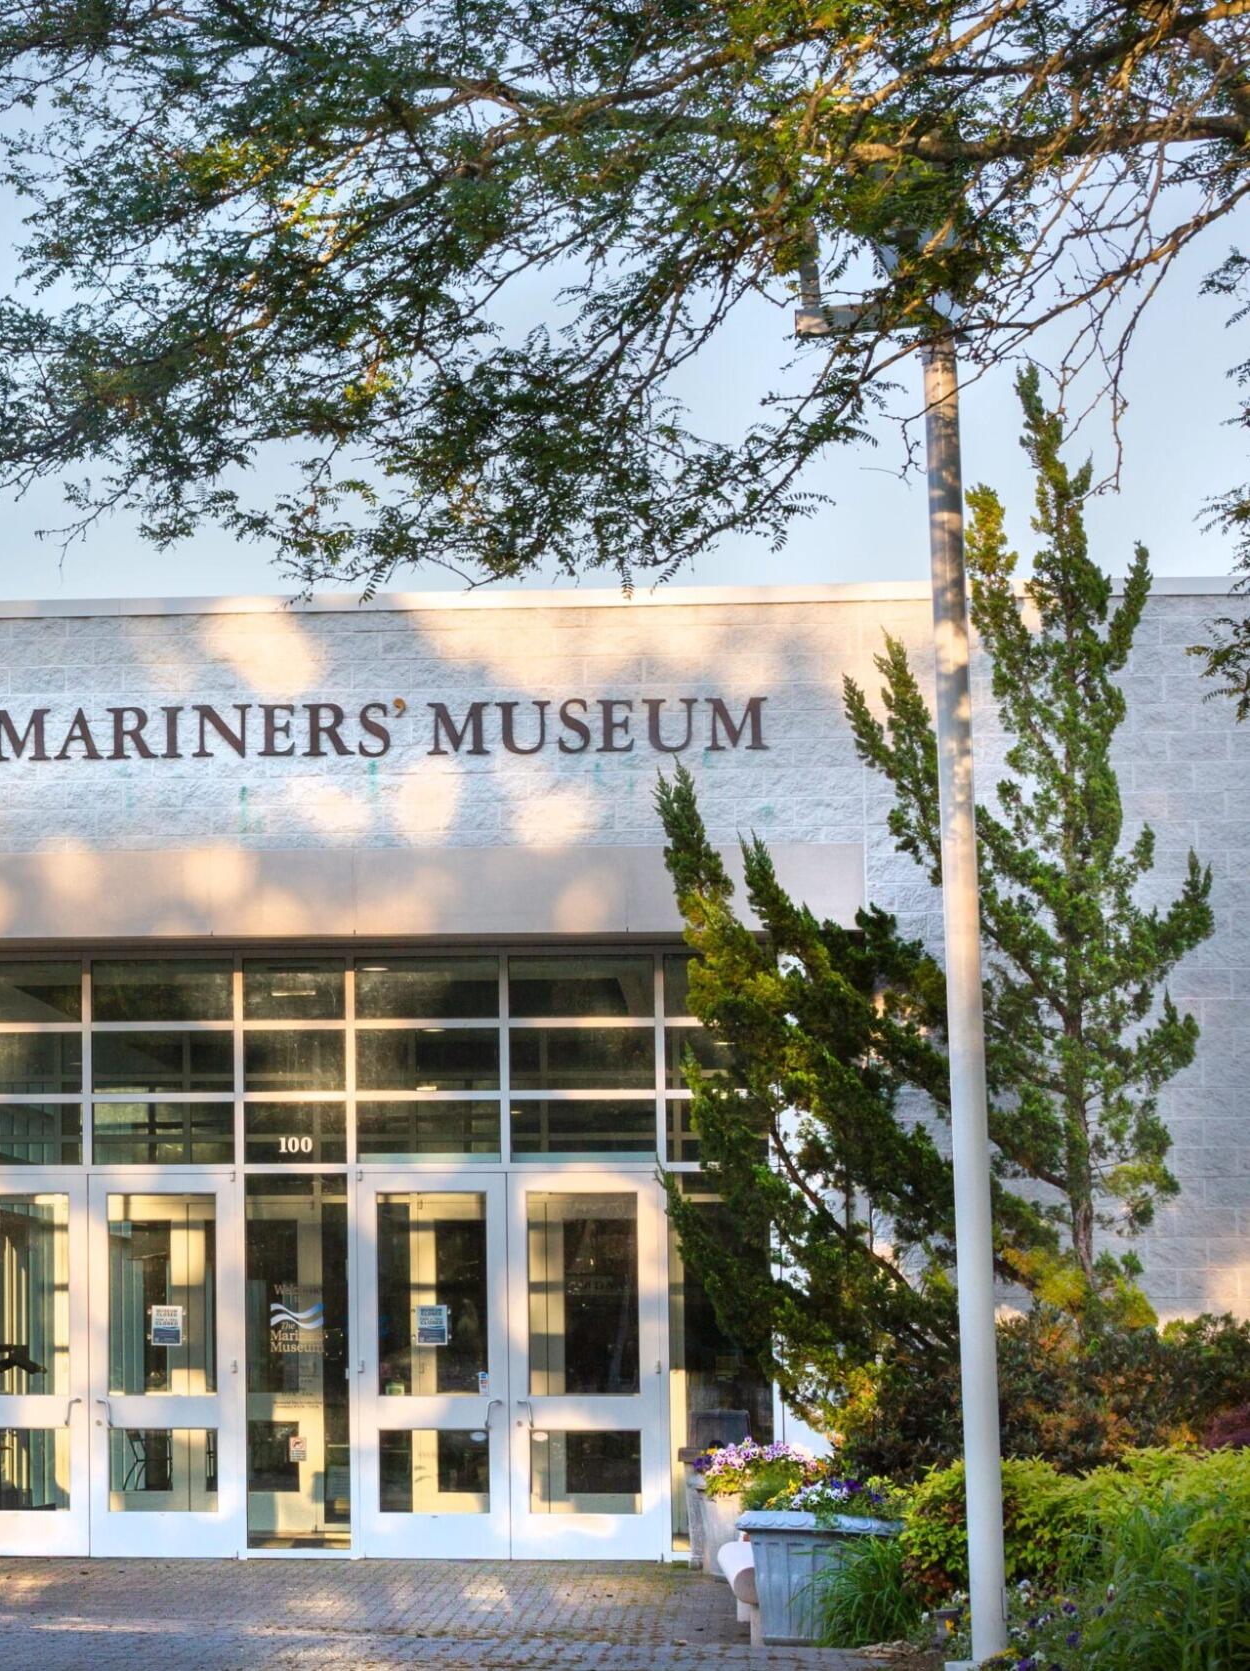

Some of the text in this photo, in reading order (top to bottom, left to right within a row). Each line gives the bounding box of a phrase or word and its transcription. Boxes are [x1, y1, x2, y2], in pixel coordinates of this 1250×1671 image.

[426, 697, 770, 756] MUSEUM
[278, 1136, 313, 1153] 100
[274, 1284, 320, 1296] Welc
[281, 1321, 296, 1330] The
[270, 1341, 325, 1353] Museum
